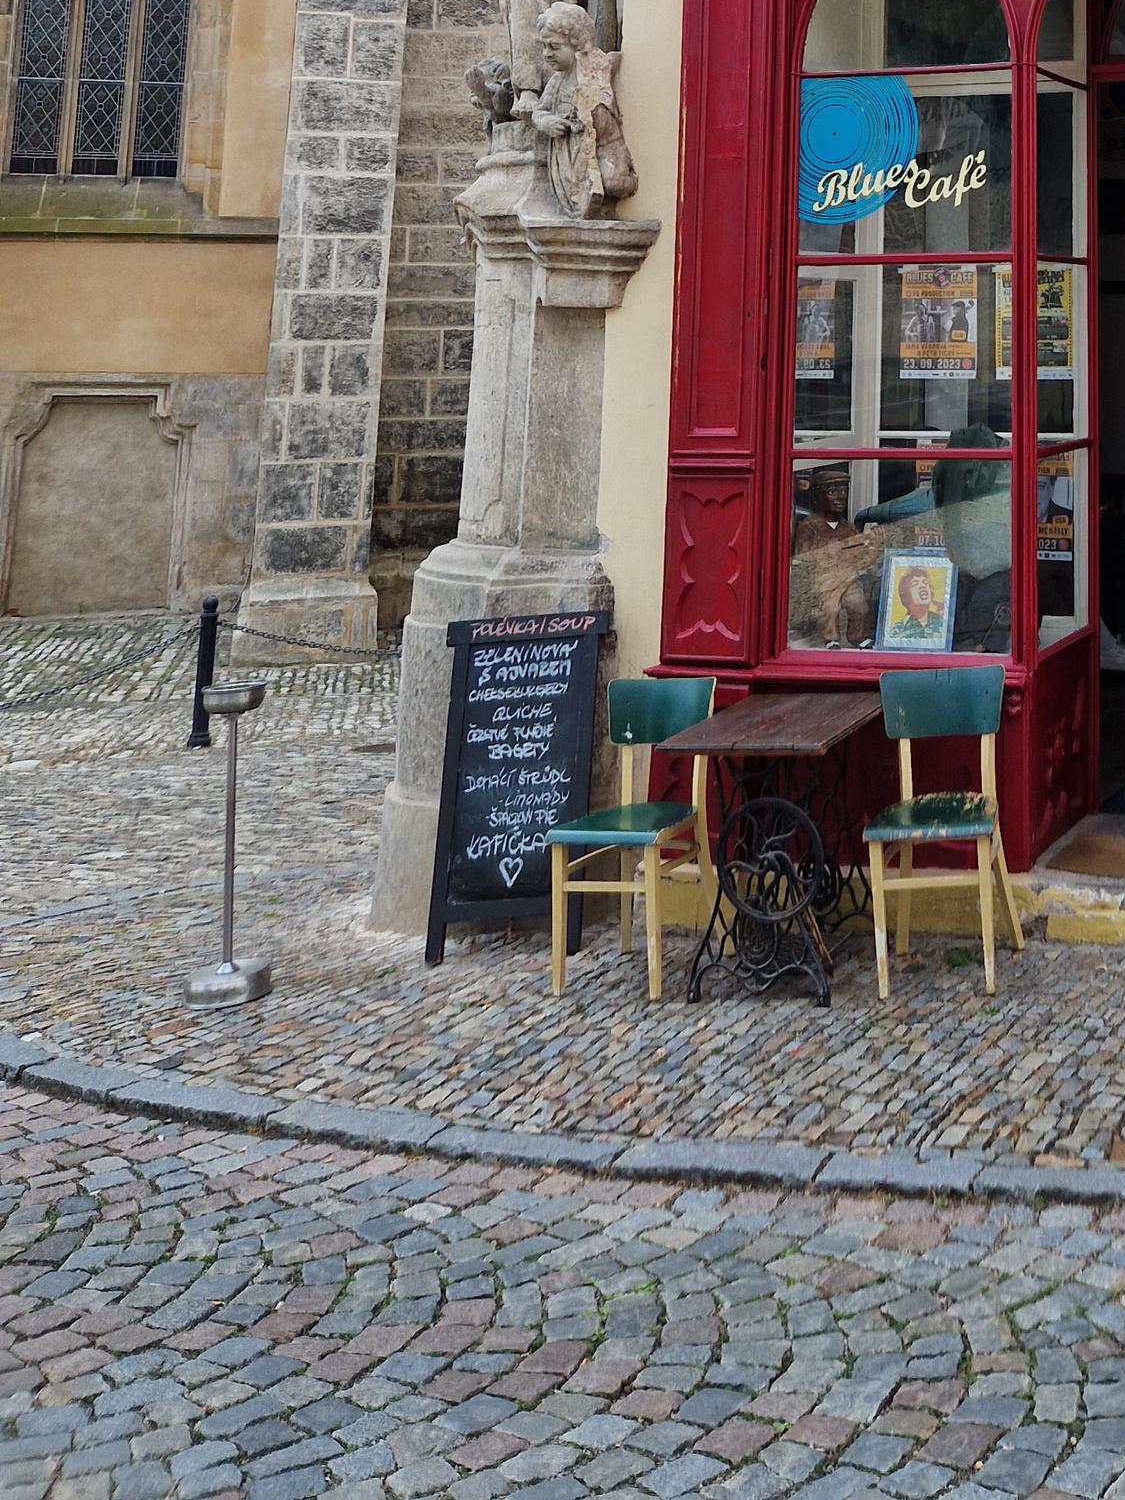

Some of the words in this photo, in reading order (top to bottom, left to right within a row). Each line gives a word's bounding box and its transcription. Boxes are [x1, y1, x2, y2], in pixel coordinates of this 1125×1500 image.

[812, 157, 921, 215] Blues
[903, 148, 988, 209] Café
[906, 271, 934, 284] BLUES
[937, 358, 961, 369] 2023
[492, 702, 553, 723] QUICHE
[487, 741, 550, 760] BAGETY
